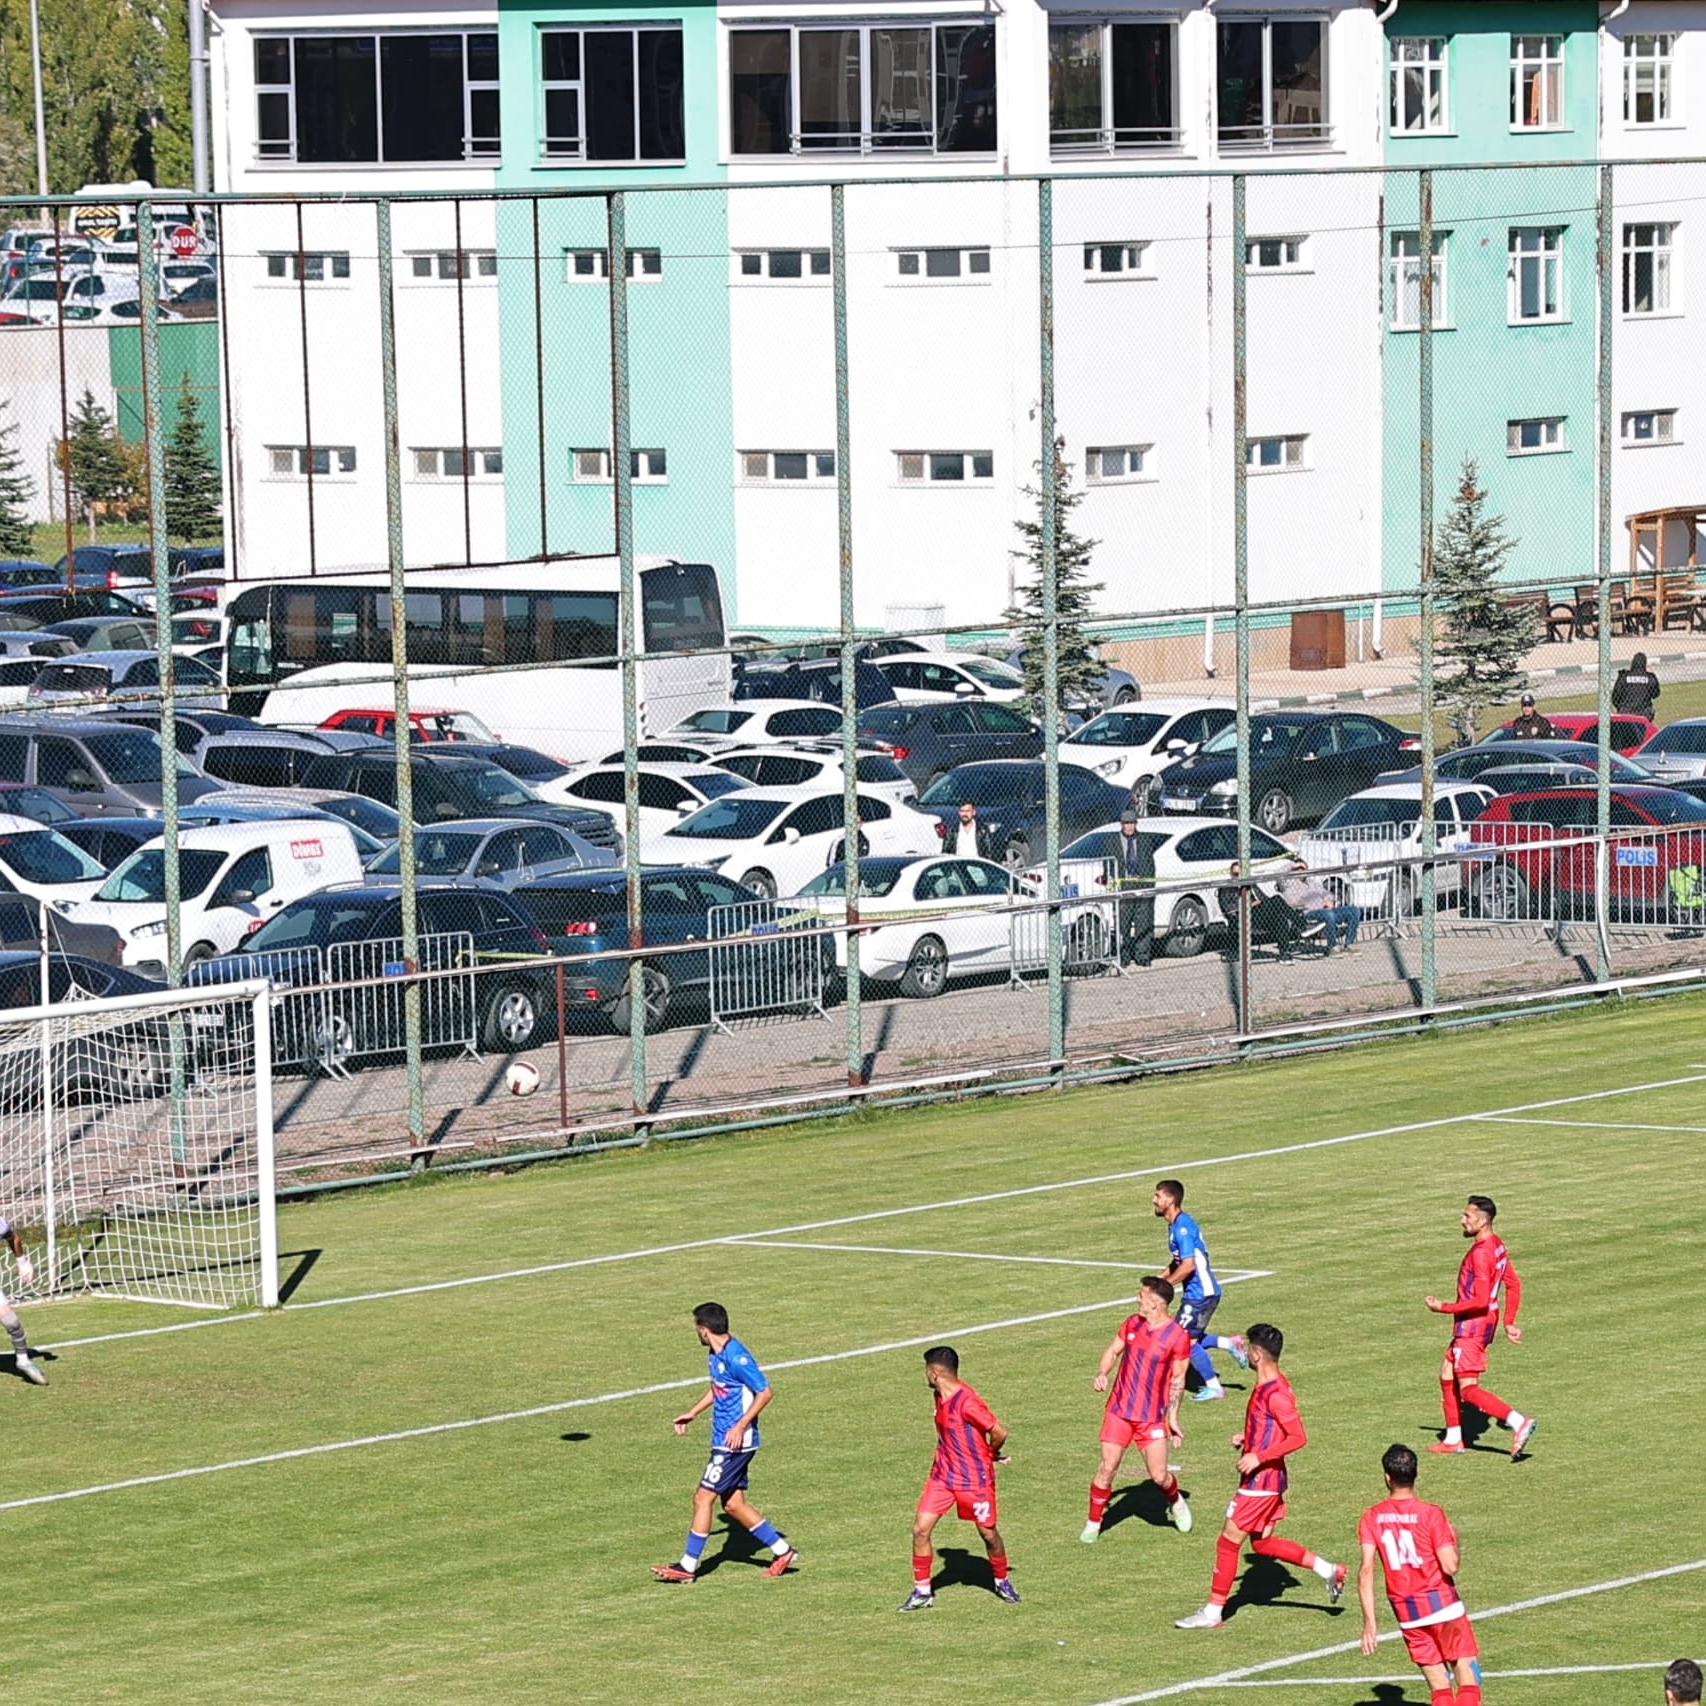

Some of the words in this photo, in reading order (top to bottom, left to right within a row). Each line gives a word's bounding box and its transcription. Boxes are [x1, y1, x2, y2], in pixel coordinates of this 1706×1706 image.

[172, 235, 197, 248] DUR
[704, 1462, 723, 1483] 16
[973, 1501, 991, 1522] 22
[1381, 1528, 1424, 1570] 14
